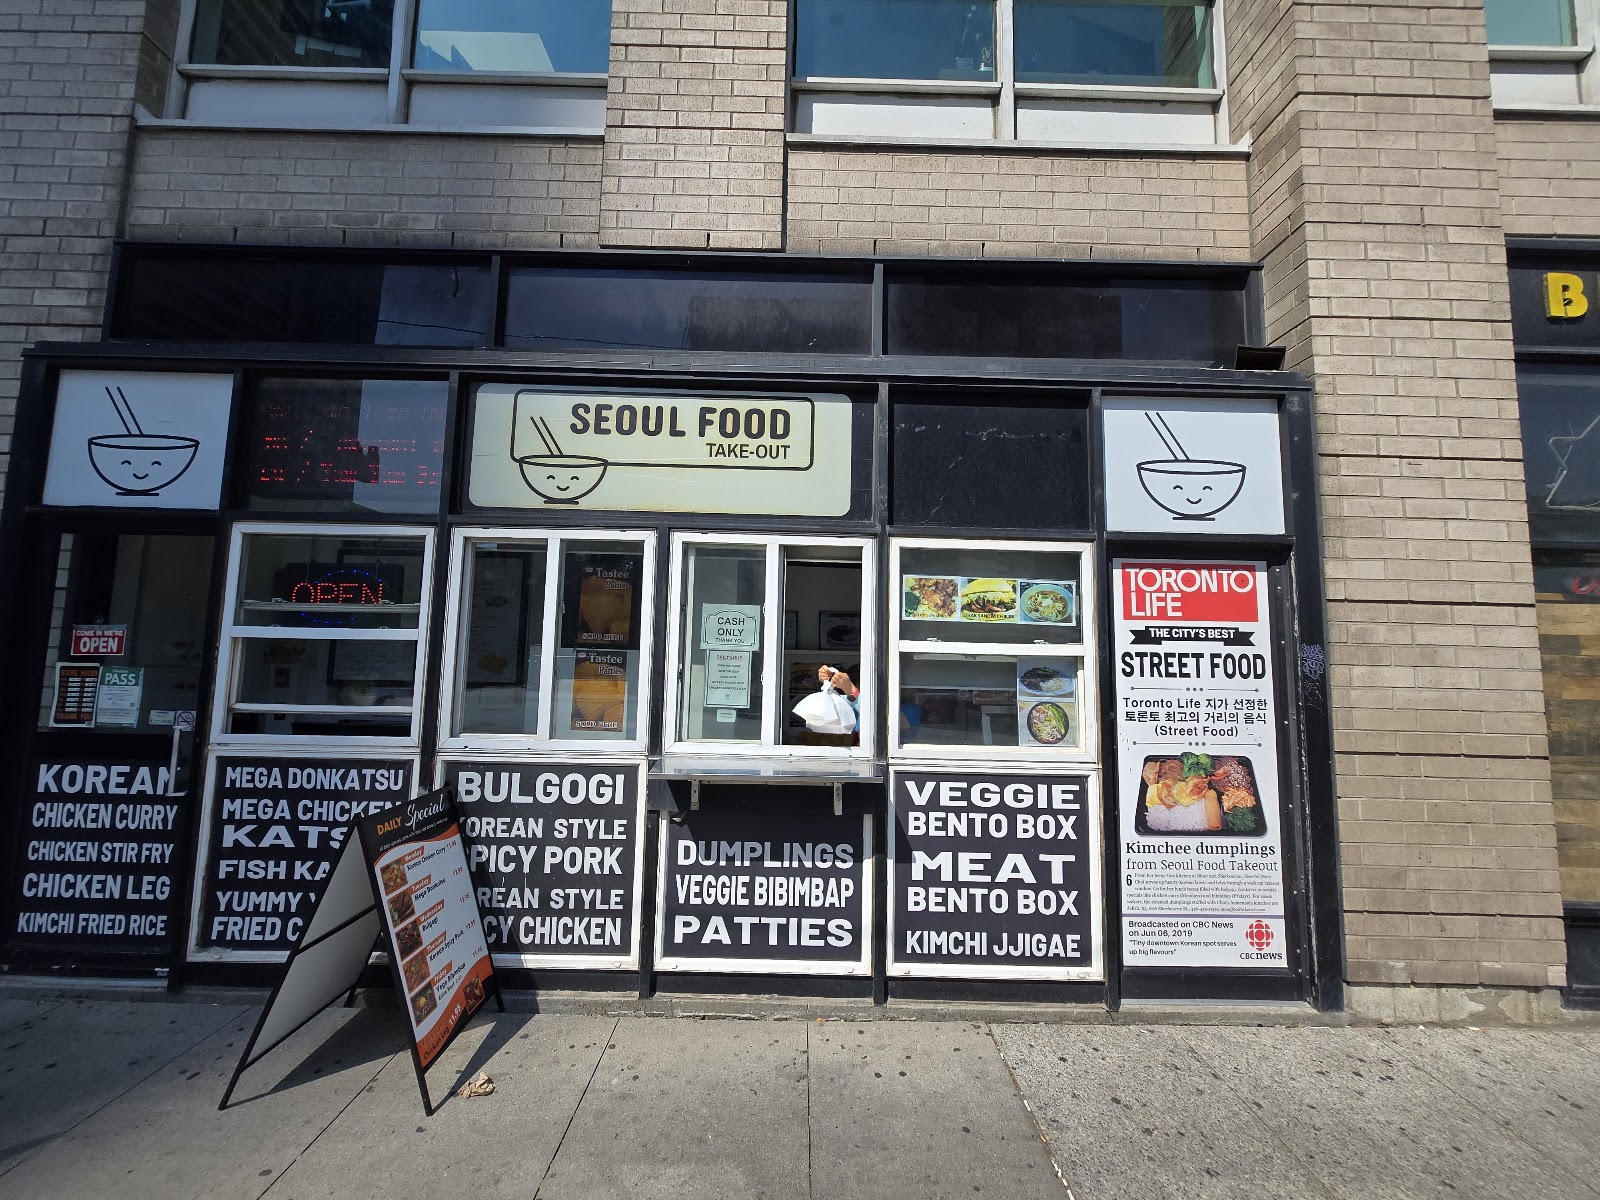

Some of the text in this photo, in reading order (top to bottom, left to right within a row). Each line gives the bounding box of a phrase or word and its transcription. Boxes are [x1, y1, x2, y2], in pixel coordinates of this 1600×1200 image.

[570, 403, 792, 440] SEOUL FOOD
[705, 442, 792, 459] TAKE-OUT
[595, 567, 630, 579] Tastee
[1125, 568, 1254, 593] TORONTO
[1130, 592, 1183, 617] LIFE
[717, 617, 745, 626] CASH
[717, 628, 745, 637] ONLY
[1149, 628, 1236, 639] THE CITY'S BEST
[79, 637, 119, 653] OPEN
[588, 652, 624, 664] Tastee
[1121, 651, 1266, 680] STREET FOOD
[104, 673, 136, 686] PASS
[1123, 698, 1268, 711] Toronto Life 지가 선정한
[1125, 711, 1267, 724] 토론토 최고의 거리의 음식
[1154, 724, 1239, 737] (Street Food)
[37, 763, 171, 795] KOREAN
[224, 766, 404, 791] MEGA DONKATSU
[456, 771, 625, 805] BULGOGI
[904, 780, 1081, 810] VEGGIE
[32, 802, 178, 830] CHICKEN CURRY
[222, 798, 402, 822] MEGA CHICKE
[376, 816, 402, 836] DAILY
[404, 794, 445, 831] Special
[459, 816, 544, 839] OREAN
[553, 818, 628, 840] STYLE
[907, 811, 1078, 840] BENTO BOX
[27, 841, 175, 864] CHICKEN STIR FRY
[465, 844, 624, 875] PICY PORK
[677, 839, 855, 869] DUMPLINGS
[1126, 840, 1276, 858] Kimchee dumplings
[218, 860, 287, 880] FISH
[911, 850, 1076, 885] MEAT
[1126, 858, 1279, 872] from Seoul Food Takeout
[22, 872, 171, 901] CHICKEN LEG
[675, 874, 855, 908] VEGGIE BIBIMBAP
[1126, 874, 1133, 886] 6
[215, 891, 304, 913] YUMMY
[549, 888, 625, 910] STYLE
[907, 886, 1080, 916] BENTO BOX
[17, 912, 168, 936] KIMCHI FRIED RICE
[210, 916, 282, 941] FRIED
[519, 916, 622, 946] CHICKEN
[673, 914, 853, 948] PATTIES
[1128, 920, 1179, 929] Broadcasted
[1193, 921, 1210, 929] CBC
[1212, 921, 1234, 929] News
[1158, 930, 1170, 938] 06,
[906, 930, 1081, 958] KIMCHI JJIGAE
[1138, 948, 1149, 956] big
